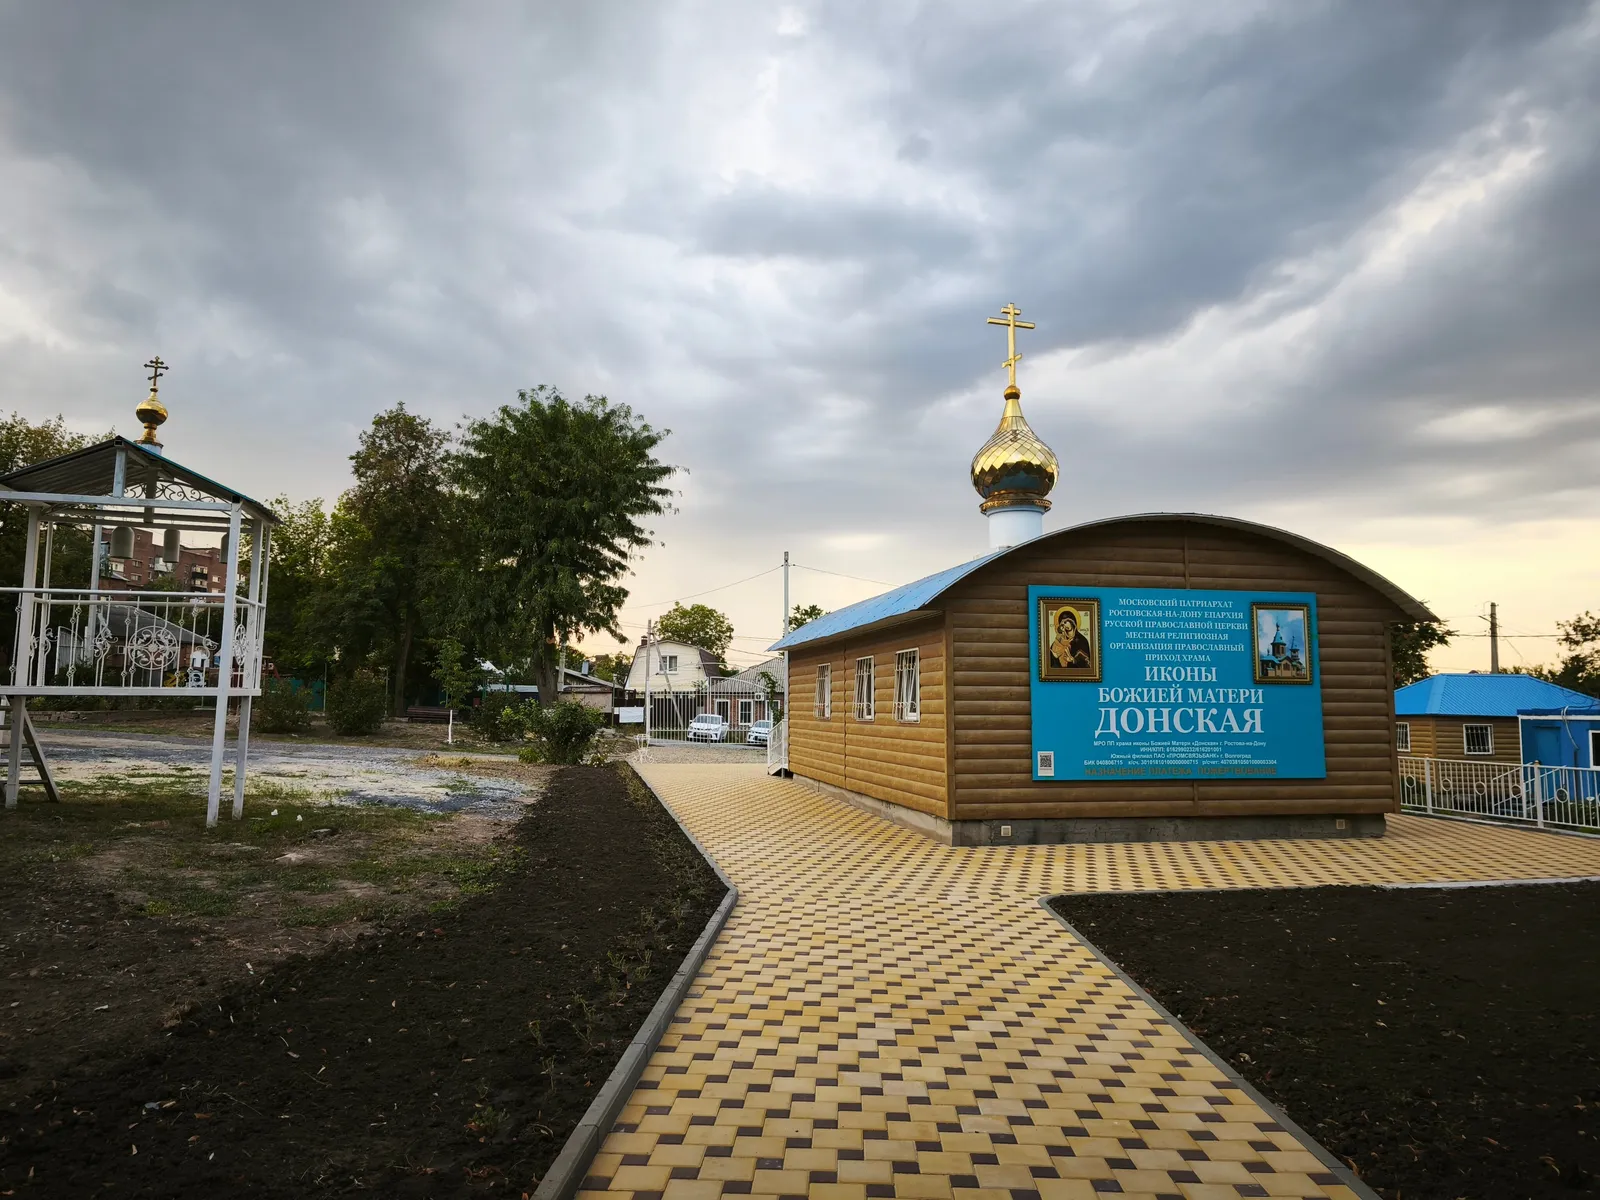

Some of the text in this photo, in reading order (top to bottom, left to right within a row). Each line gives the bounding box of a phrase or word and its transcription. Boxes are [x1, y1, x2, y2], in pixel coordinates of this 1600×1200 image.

[1118, 598, 1234, 608] МОСКОВСКИЙ ПАТРИАРХАТ
[1109, 610, 1202, 618] РОСТОВСКАЯ-НА-ДОНУ
[1104, 620, 1144, 628] РУССКОЙ
[1145, 621, 1213, 629] ПРАВОСЛАВНОЙ
[1167, 632, 1228, 640] РЕЛИГИОЗНАЯ
[1110, 642, 1244, 652] ОРГАНИЗАЦИЯ ПРАВОСЛАВНЫЙ
[1145, 654, 1180, 662] ПРИХОД
[1144, 666, 1218, 682] ИКОНЫ
[1098, 684, 1264, 704] БОЖИЕЙ МАТЕРИ
[1094, 707, 1265, 739] ДОНСКАЯ
[1085, 767, 1146, 776] НАЗНАЧЕНИЕ
